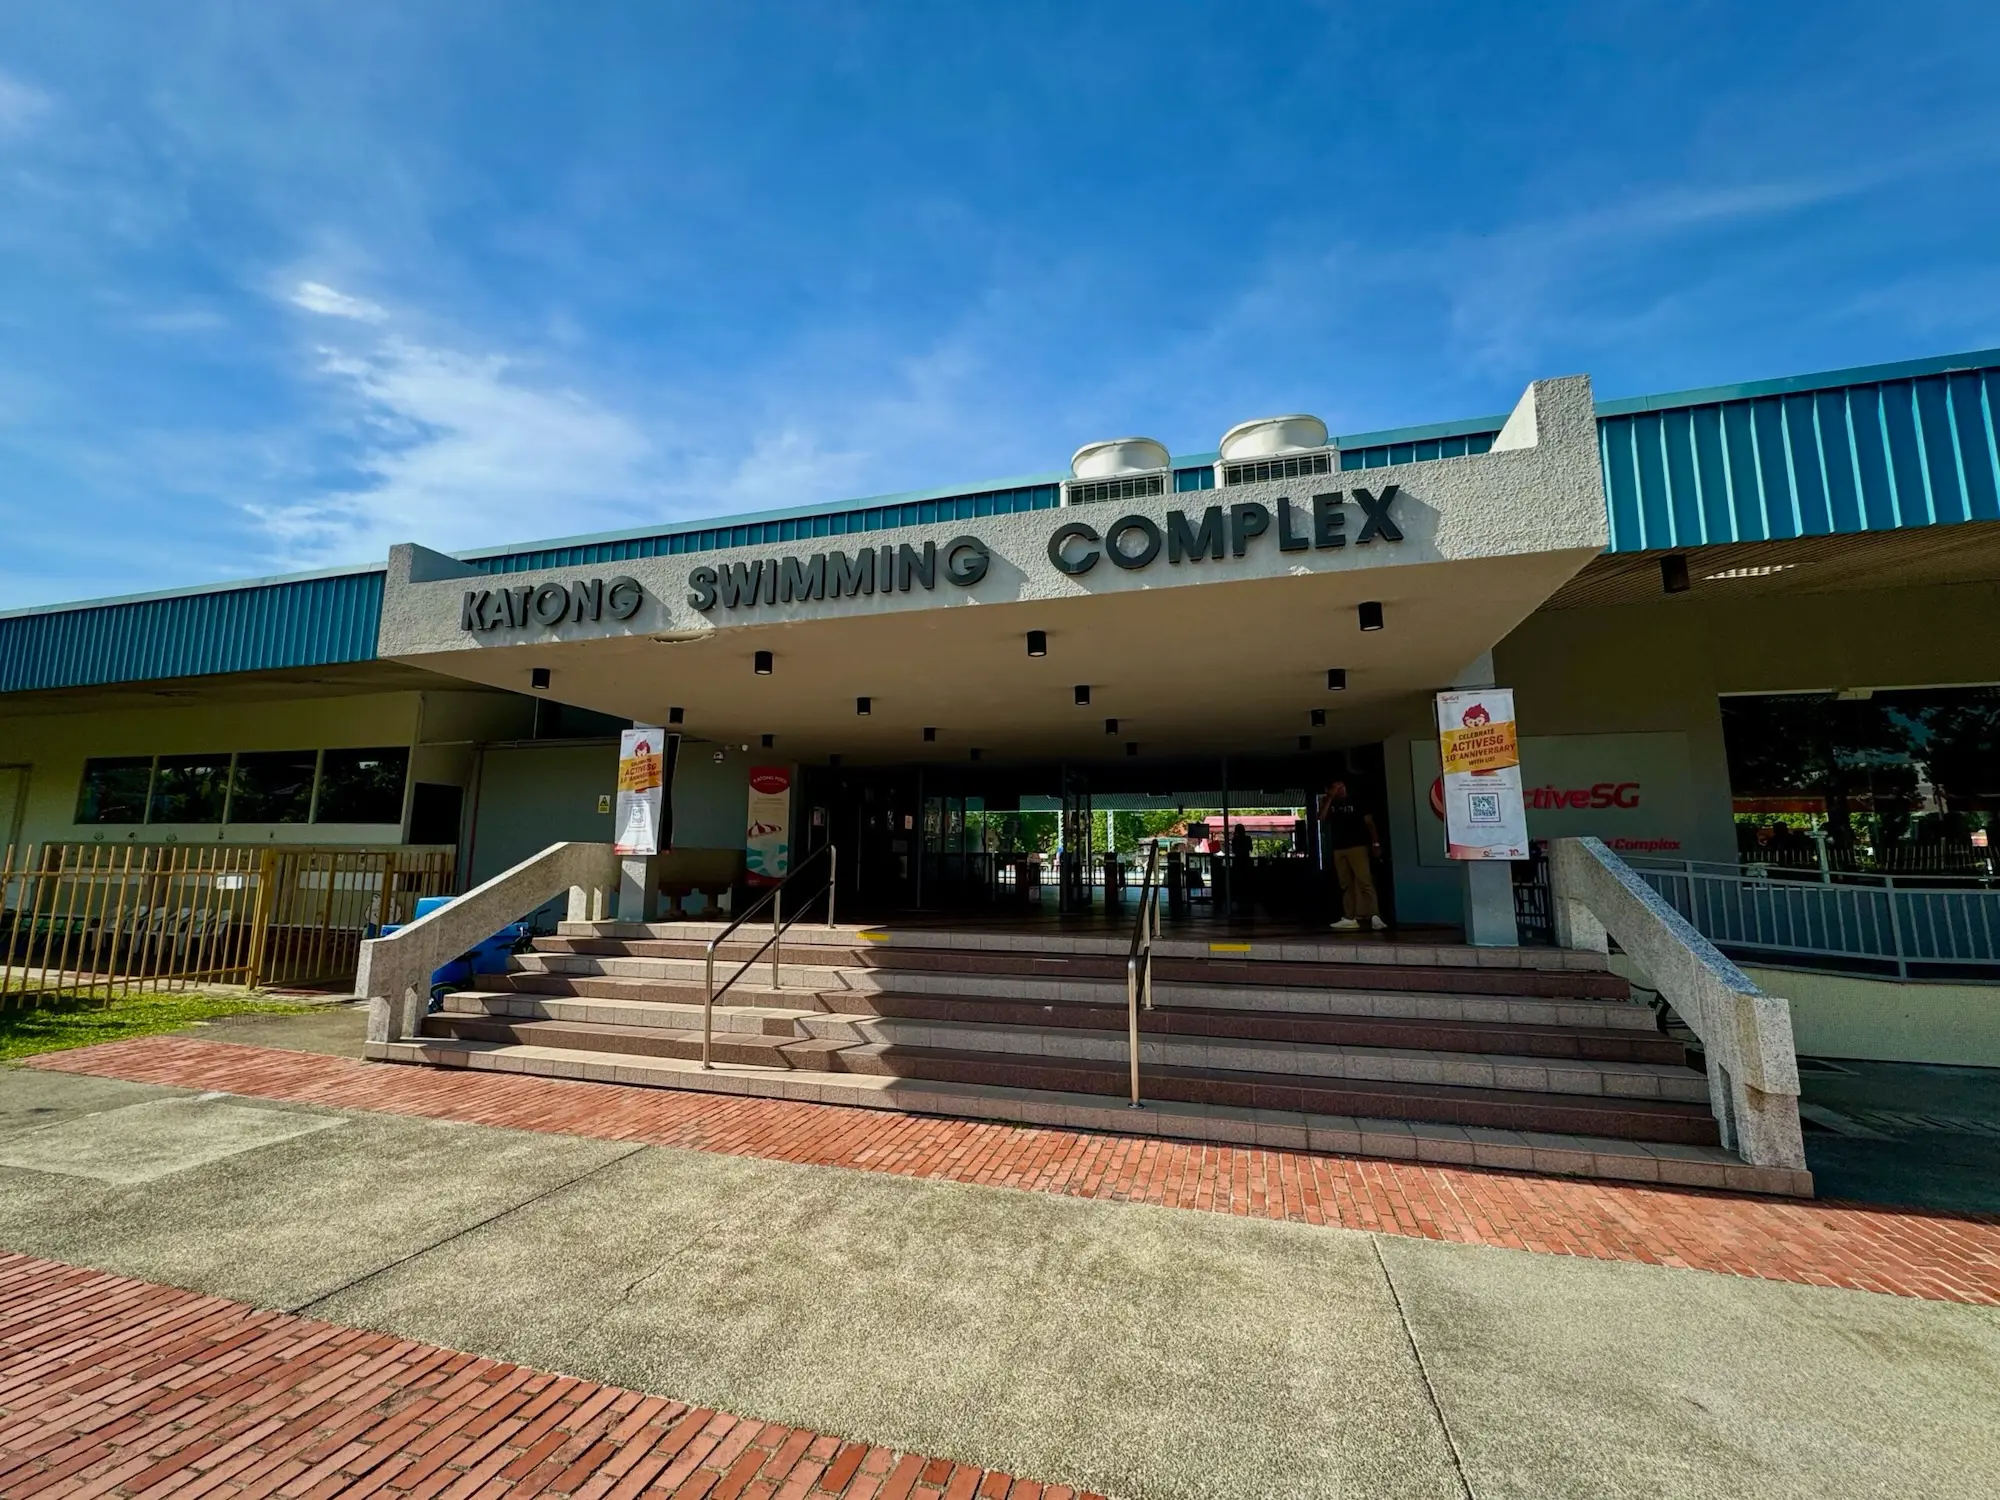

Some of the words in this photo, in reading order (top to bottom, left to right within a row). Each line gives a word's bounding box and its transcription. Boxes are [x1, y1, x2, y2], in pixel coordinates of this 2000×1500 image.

[461, 575, 643, 631] KATONG
[687, 535, 990, 612] SWIMMING
[1048, 485, 1404, 574] COMPLEX
[1450, 734, 1504, 753] ACTIVESG
[1458, 728, 1495, 741] CELEBRATE
[1459, 743, 1515, 760] ANNIVERSARY
[1523, 781, 1641, 810] ctiveSG
